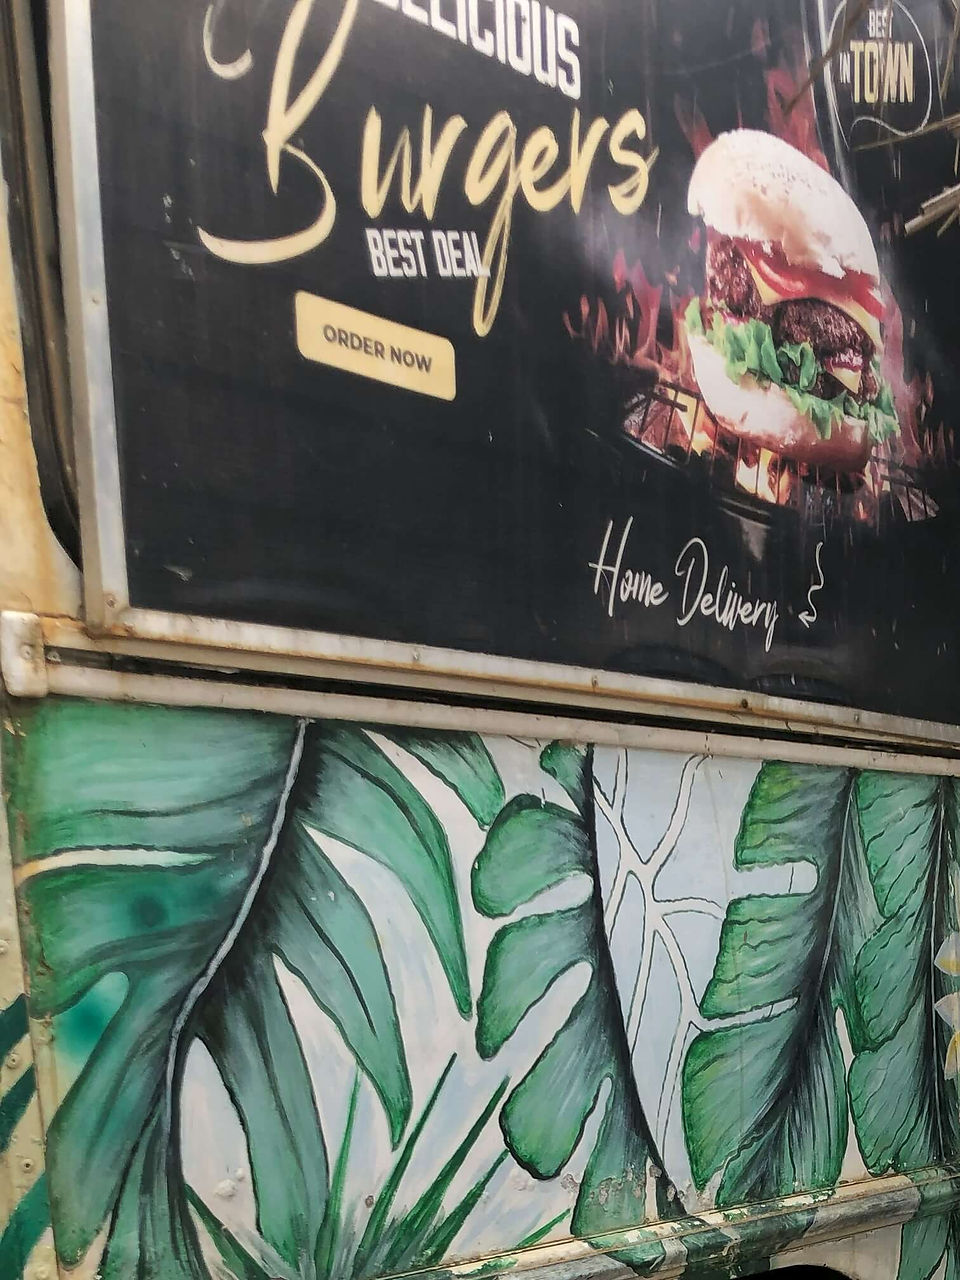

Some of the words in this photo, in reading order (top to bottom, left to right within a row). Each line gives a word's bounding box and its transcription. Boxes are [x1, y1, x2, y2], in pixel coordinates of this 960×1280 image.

[198, 0, 659, 337] Burgers
[365, 227, 428, 278] BEST
[431, 229, 492, 278] DEAL
[323, 323, 386, 361] ORDER
[389, 347, 433, 374] NOW
[588, 515, 669, 618] Home
[675, 537, 779, 653] Delivery
